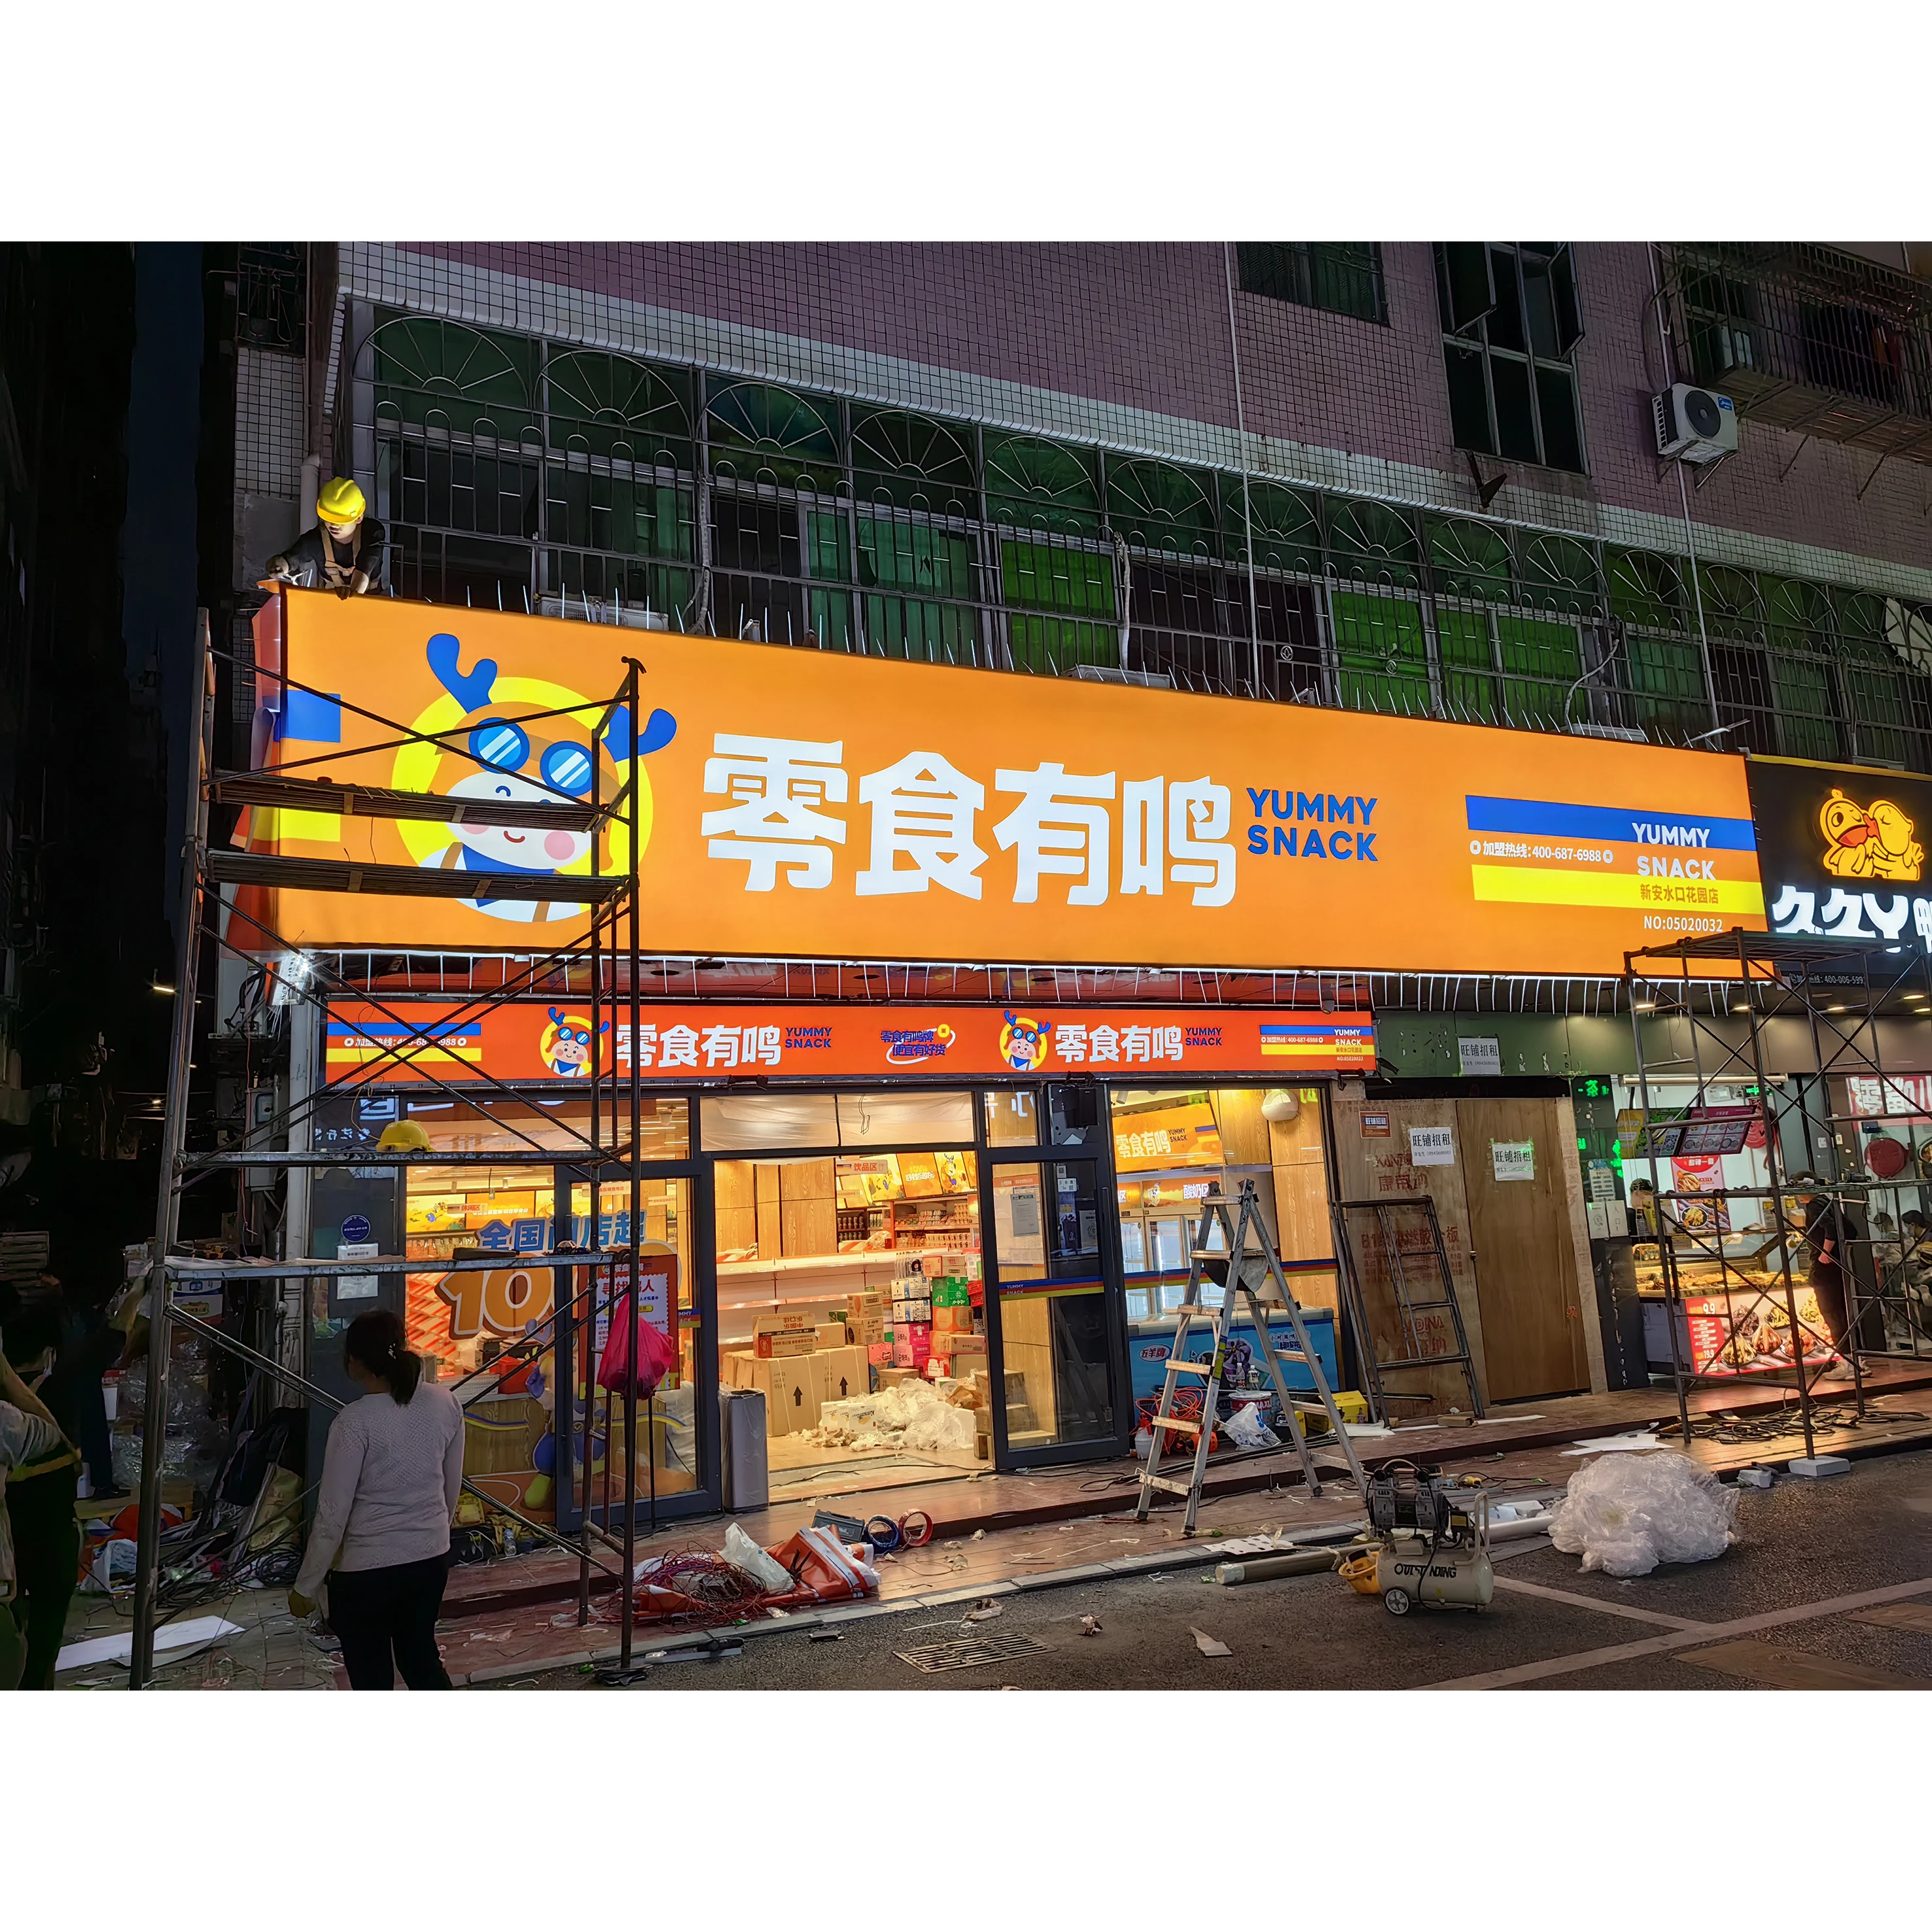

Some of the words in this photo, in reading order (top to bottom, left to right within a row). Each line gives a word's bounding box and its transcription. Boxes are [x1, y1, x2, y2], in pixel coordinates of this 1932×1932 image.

[1246, 787, 1378, 826] YUMMY
[701, 732, 1236, 907] 零食有鸣
[1247, 825, 1379, 862] SNACK
[1632, 822, 1710, 849] YUMMY
[1637, 856, 1716, 881] SNACK
[1640, 883, 1719, 905] 新安水口花园店
[1643, 915, 1723, 933] NO:05020032
[785, 1027, 834, 1037] YUMMY
[1185, 1027, 1223, 1036] YUMMY
[616, 1024, 781, 1068] 零食有鸣
[785, 1038, 833, 1049] SNACK
[1055, 1024, 1184, 1063] 零食有鸣
[1185, 1037, 1223, 1046] SNACK
[1461, 1044, 1498, 1057] 旺铺招租
[1168, 1127, 1186, 1136] YUMMY
[1115, 1129, 1171, 1159] 零食有鸣
[1413, 1133, 1451, 1147] 旺铺招租
[1495, 1150, 1531, 1163] 旺铺招租
[854, 1163, 877, 1172] 饮品区
[1141, 1347, 1166, 1358] 五羊牌
